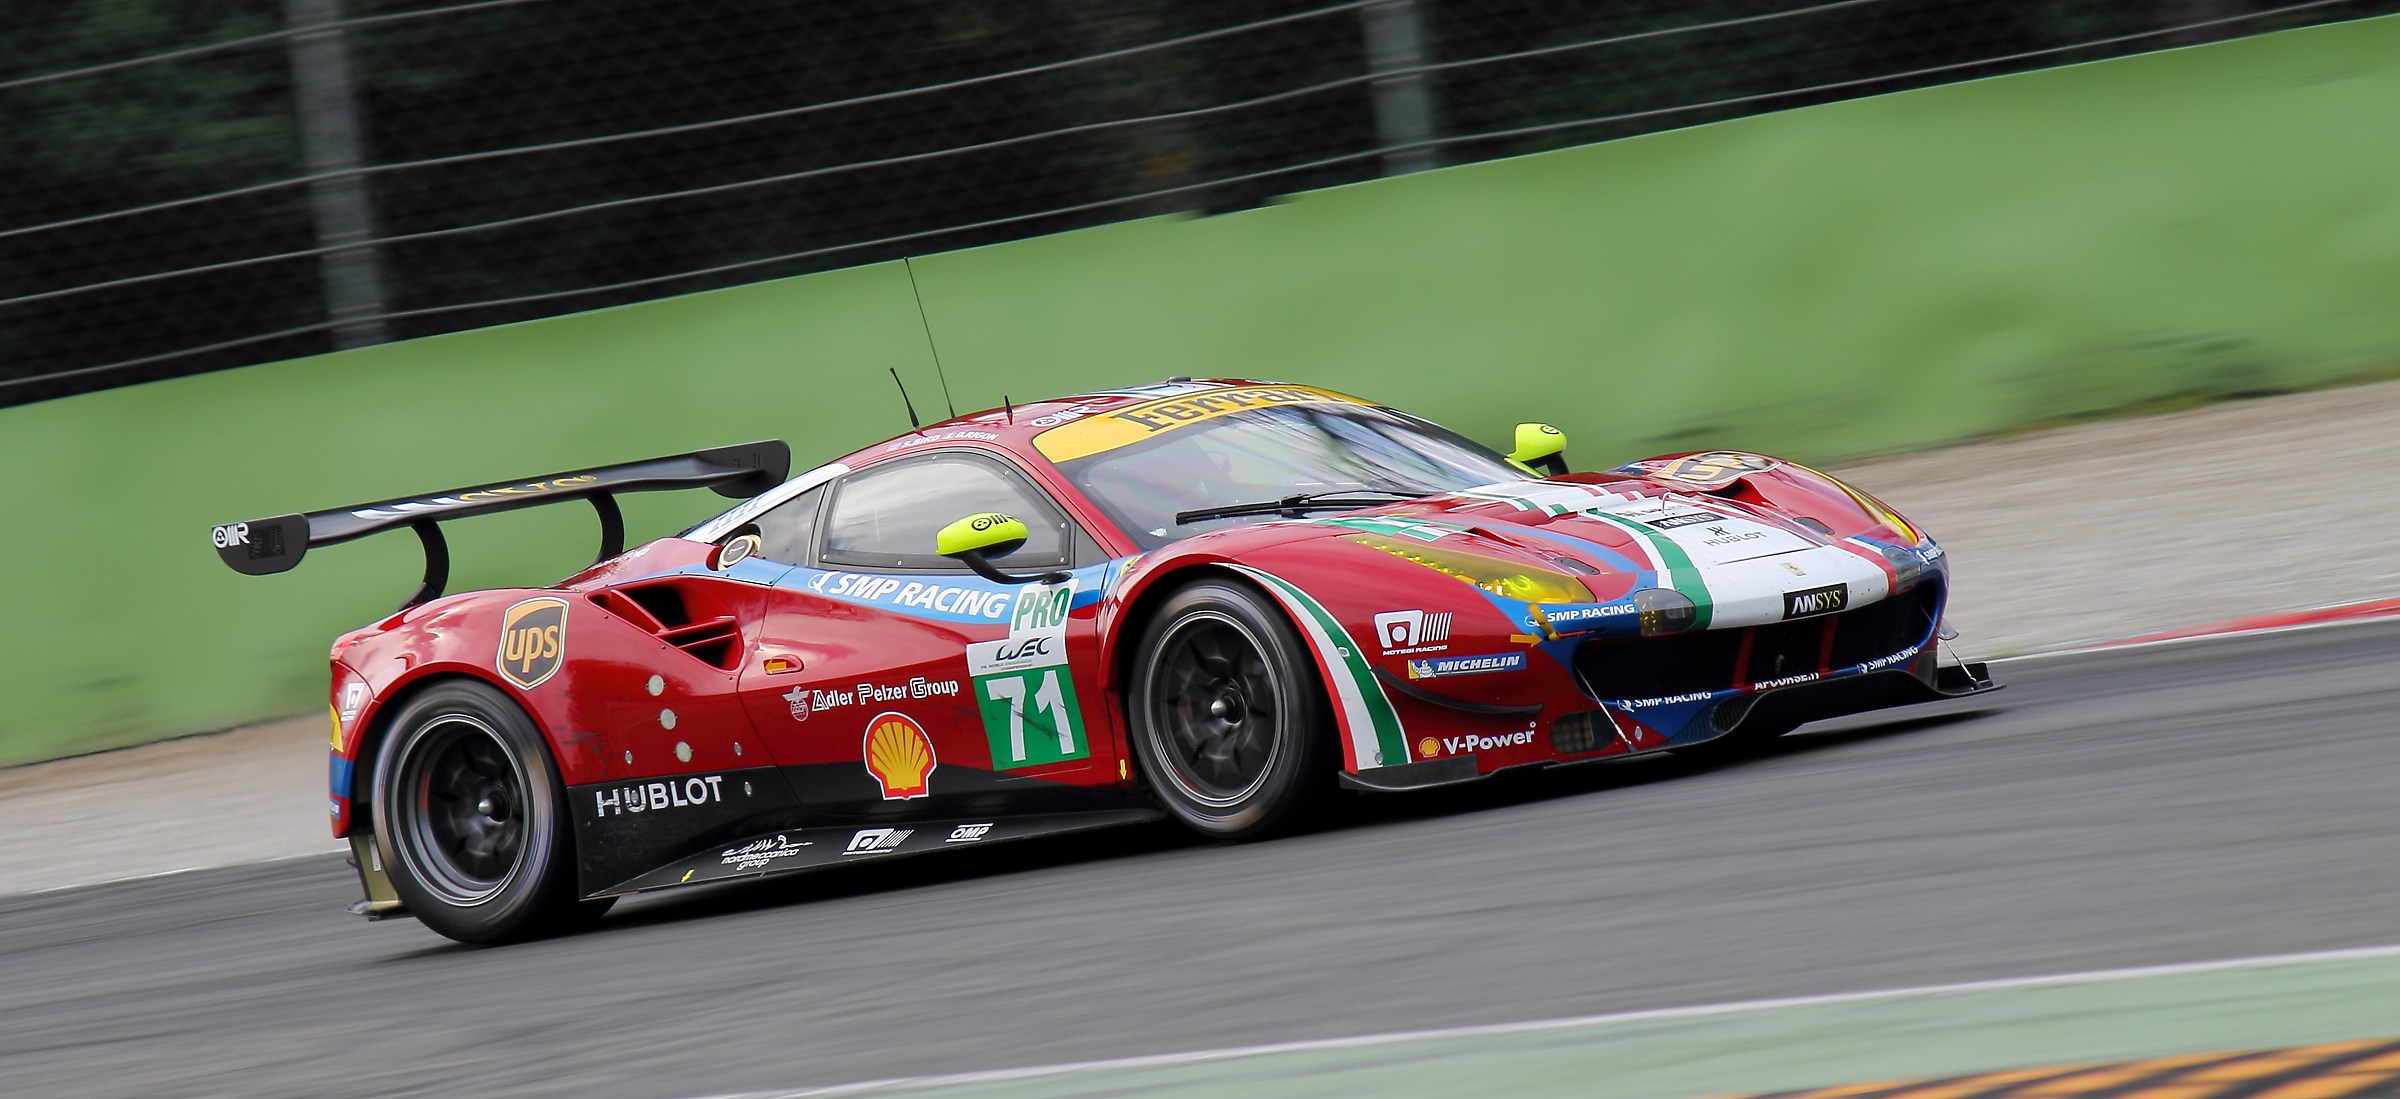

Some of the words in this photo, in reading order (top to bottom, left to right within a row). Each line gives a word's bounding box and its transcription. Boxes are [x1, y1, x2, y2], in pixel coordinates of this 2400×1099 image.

[1108, 386, 1346, 433] Ferrari
[902, 434, 940, 448] S.BIRD
[1703, 531, 1768, 547] HUBLOT
[829, 573, 893, 600] SMP
[893, 579, 1011, 619] RACING
[1791, 590, 1842, 616] ANSYS
[1013, 586, 1069, 633] PRO
[1547, 609, 1580, 623] SMP
[1581, 603, 1636, 619] RACING
[505, 624, 560, 674] ups
[996, 636, 1053, 661] WEC
[1382, 648, 1415, 656] MOTEGI
[1415, 645, 1448, 653] RACING
[1436, 655, 1520, 670] MICHELIN
[811, 689, 854, 713] Adler
[857, 683, 908, 707] Pelzer
[909, 676, 959, 700] Group
[985, 669, 1076, 763] 71
[1443, 728, 1536, 755] V-Power
[596, 775, 724, 818] HUBLOT
[950, 826, 990, 839] OMP
[721, 848, 800, 865] nordmeccanica
[736, 858, 770, 871] group
